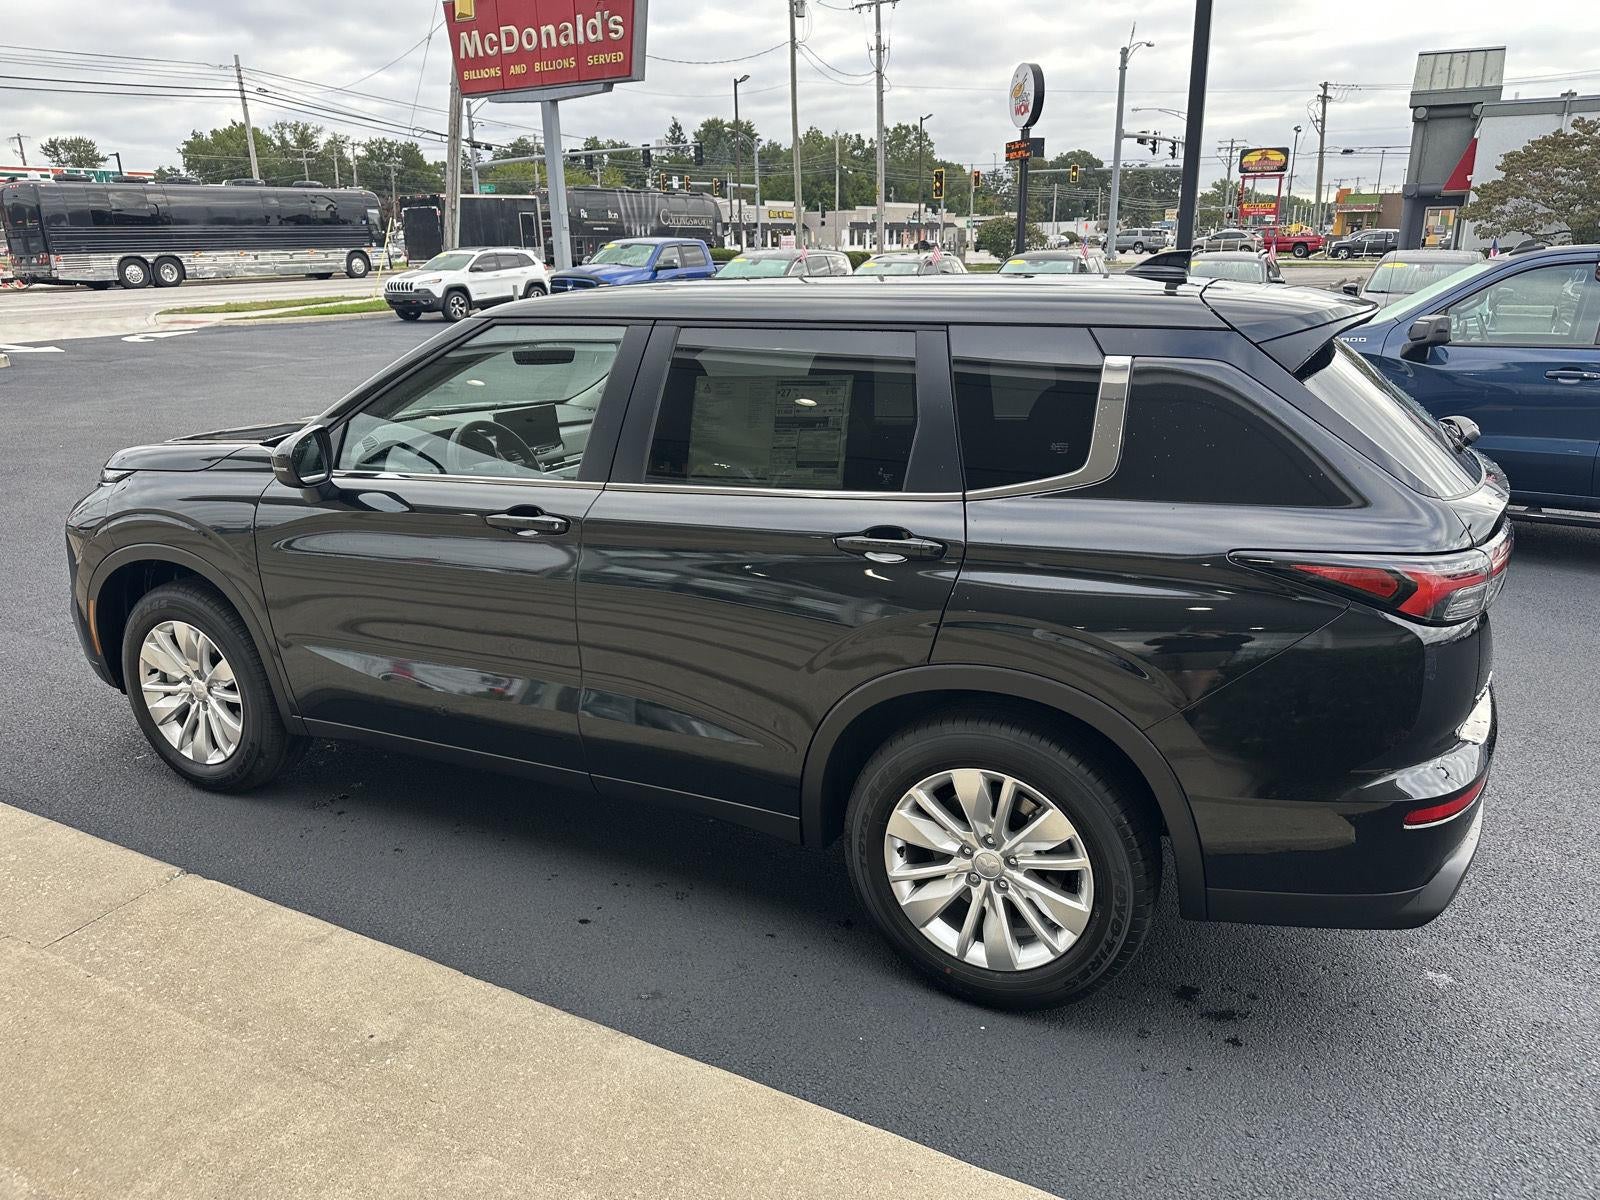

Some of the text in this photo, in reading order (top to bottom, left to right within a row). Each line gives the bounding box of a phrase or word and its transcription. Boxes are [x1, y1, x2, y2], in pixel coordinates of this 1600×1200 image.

[459, 10, 625, 60] McDonald's
[463, 52, 624, 81] BILLIONS AND BILLIONS SERVED
[1014, 103, 1030, 116] WOK
[660, 208, 712, 226] COLLINGSWORTH
